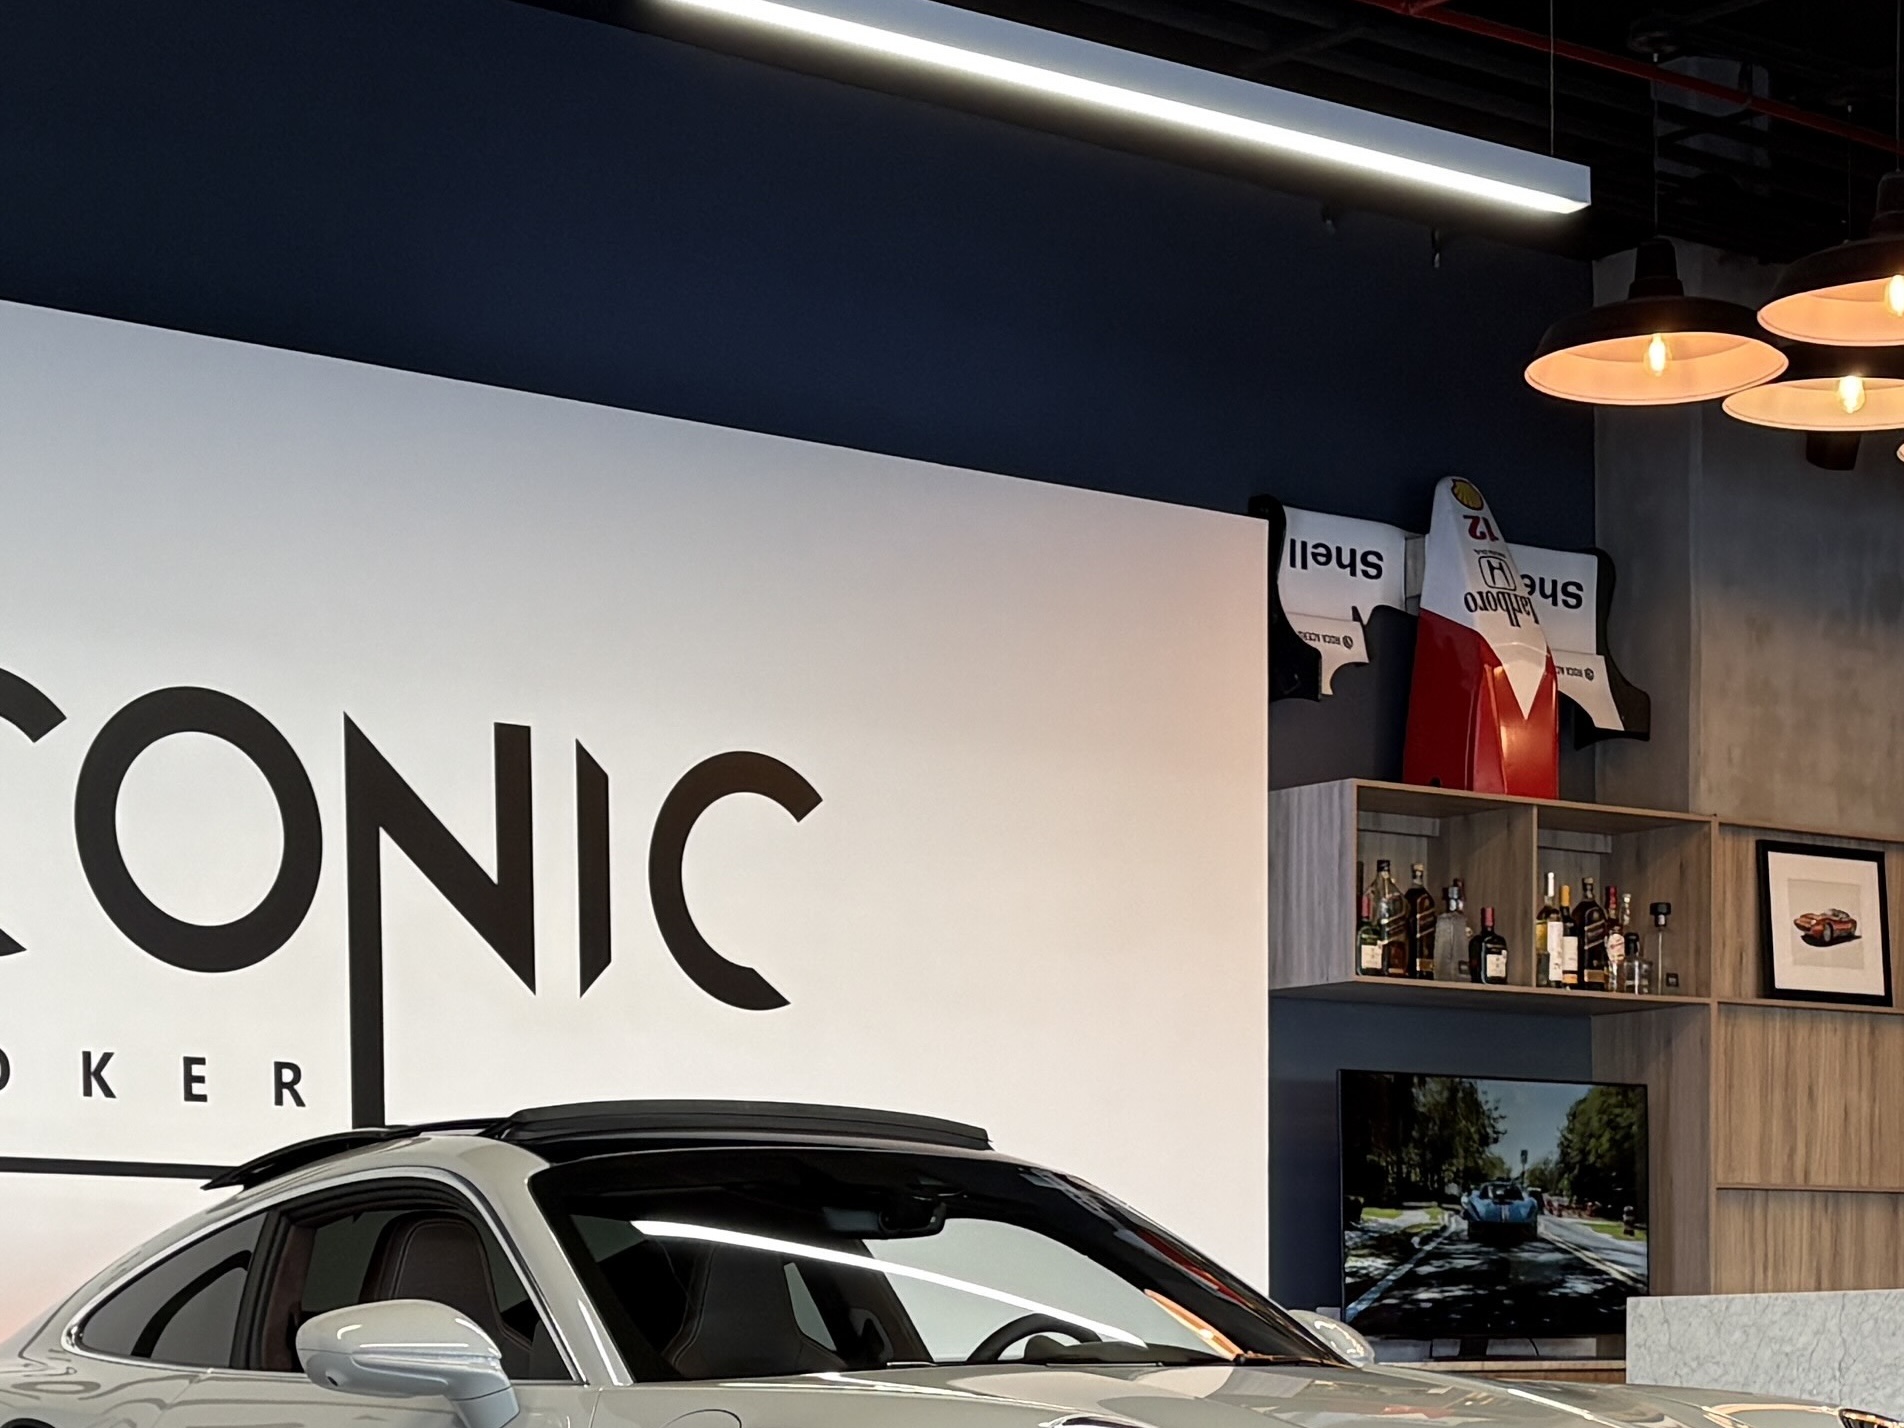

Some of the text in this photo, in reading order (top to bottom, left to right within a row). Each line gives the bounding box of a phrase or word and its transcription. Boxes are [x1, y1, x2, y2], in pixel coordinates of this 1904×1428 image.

[1462, 514, 1500, 543] 12
[1289, 537, 1385, 581] Shell
[1521, 572, 1586, 610] She
